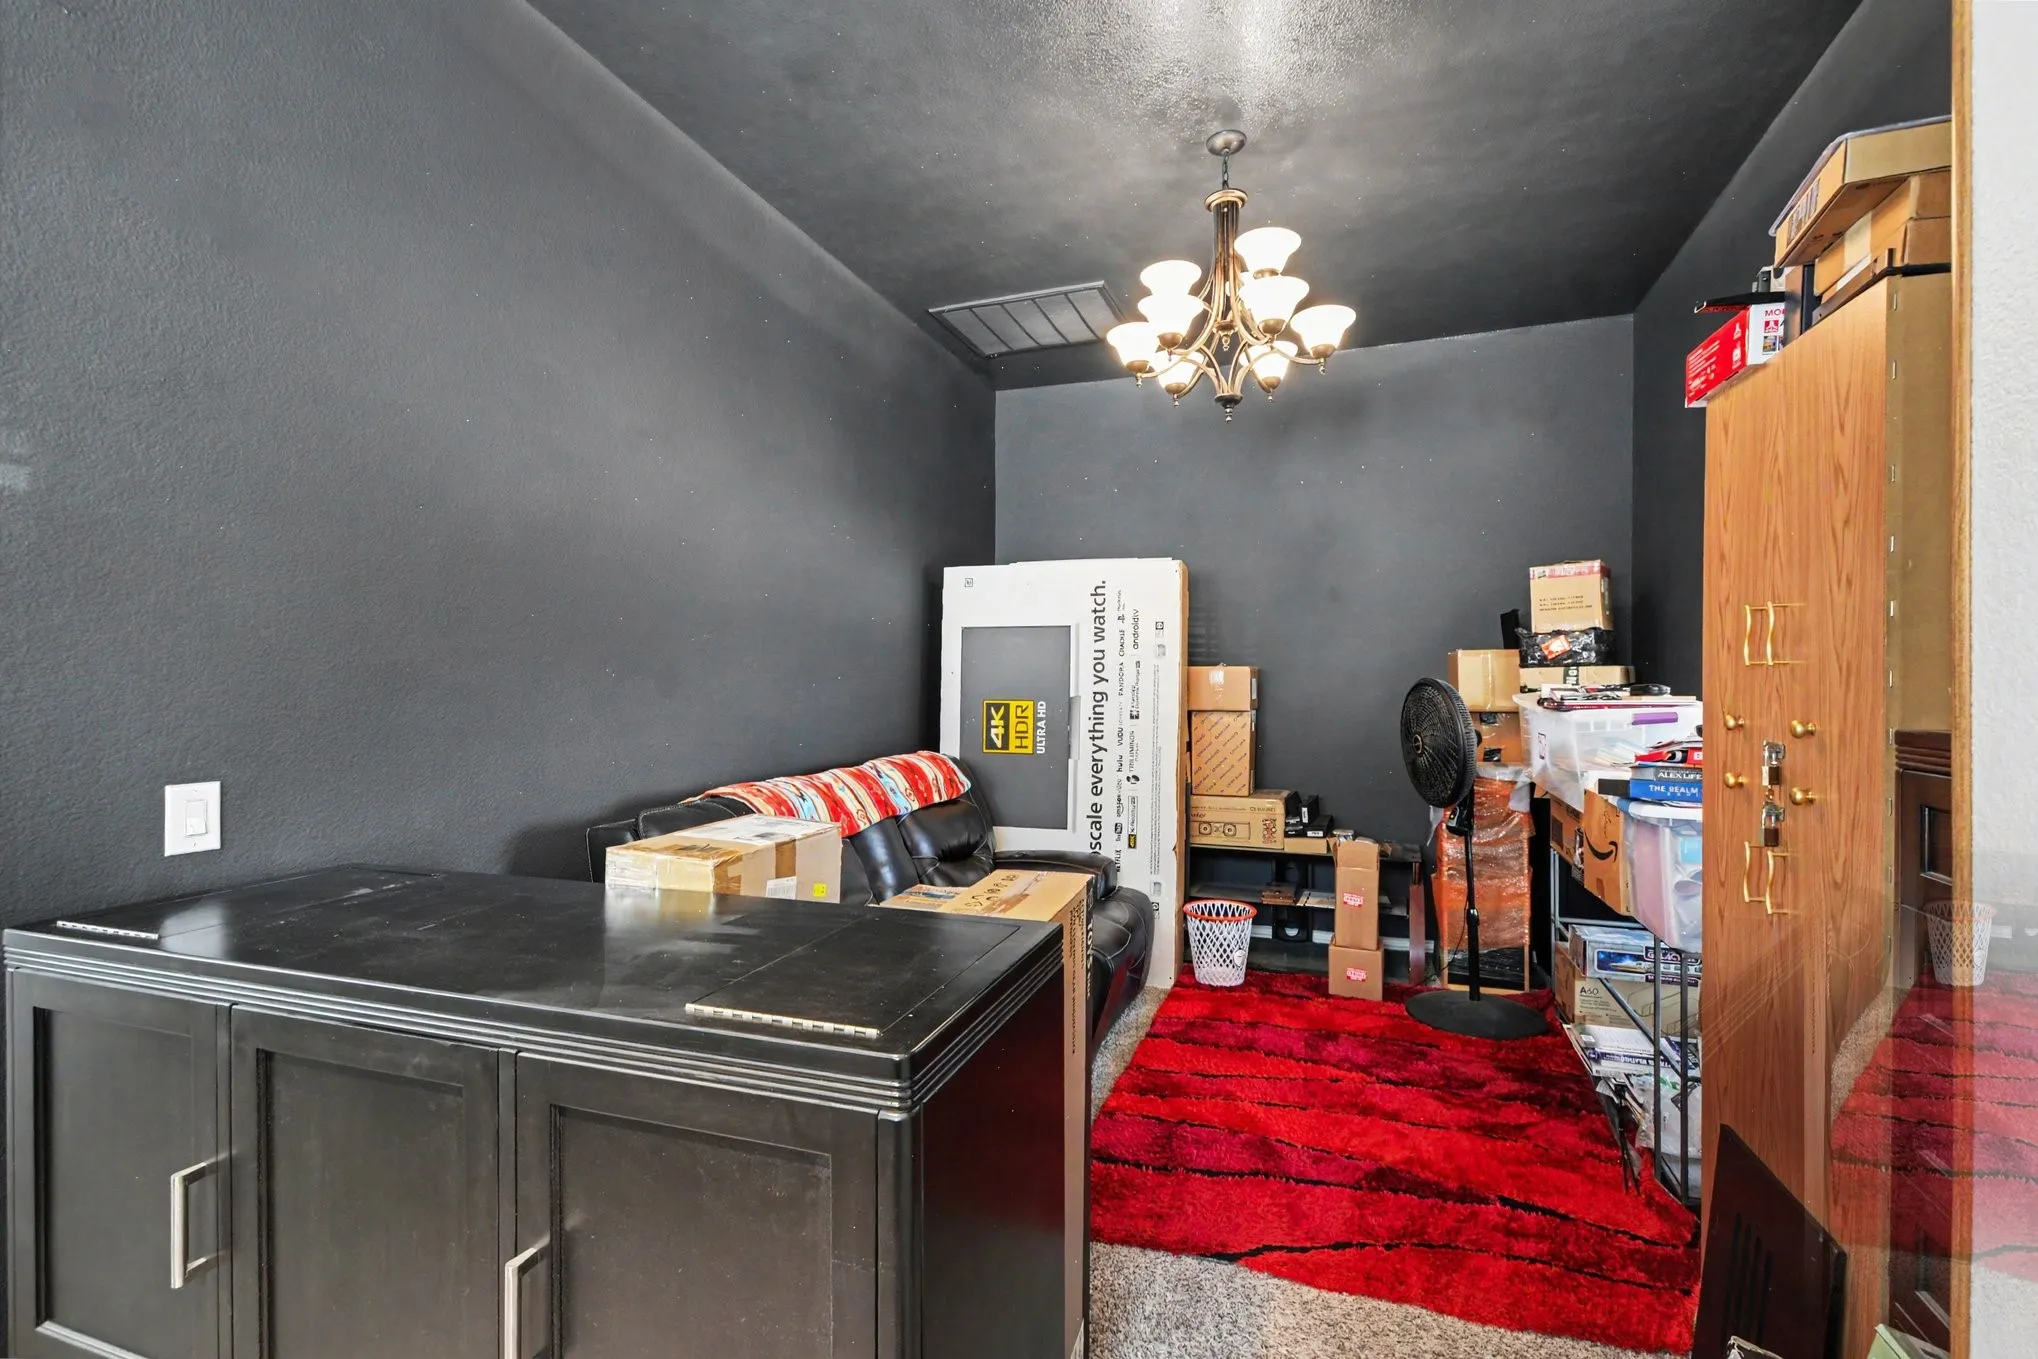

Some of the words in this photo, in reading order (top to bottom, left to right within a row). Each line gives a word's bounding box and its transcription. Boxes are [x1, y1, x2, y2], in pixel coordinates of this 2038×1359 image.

[1089, 580, 1106, 643] watch.
[1092, 649, 1108, 686] you
[991, 705, 1004, 748] 4K
[1015, 705, 1029, 749] HDR
[1037, 701, 1046, 718] HD
[1036, 719, 1046, 754] ULTRA
[1088, 692, 1108, 796] everything
[1116, 727, 1124, 746] VUDU
[1649, 784, 1666, 792] THE
[1669, 786, 1699, 794] REALM
[1086, 803, 1103, 855] scale
